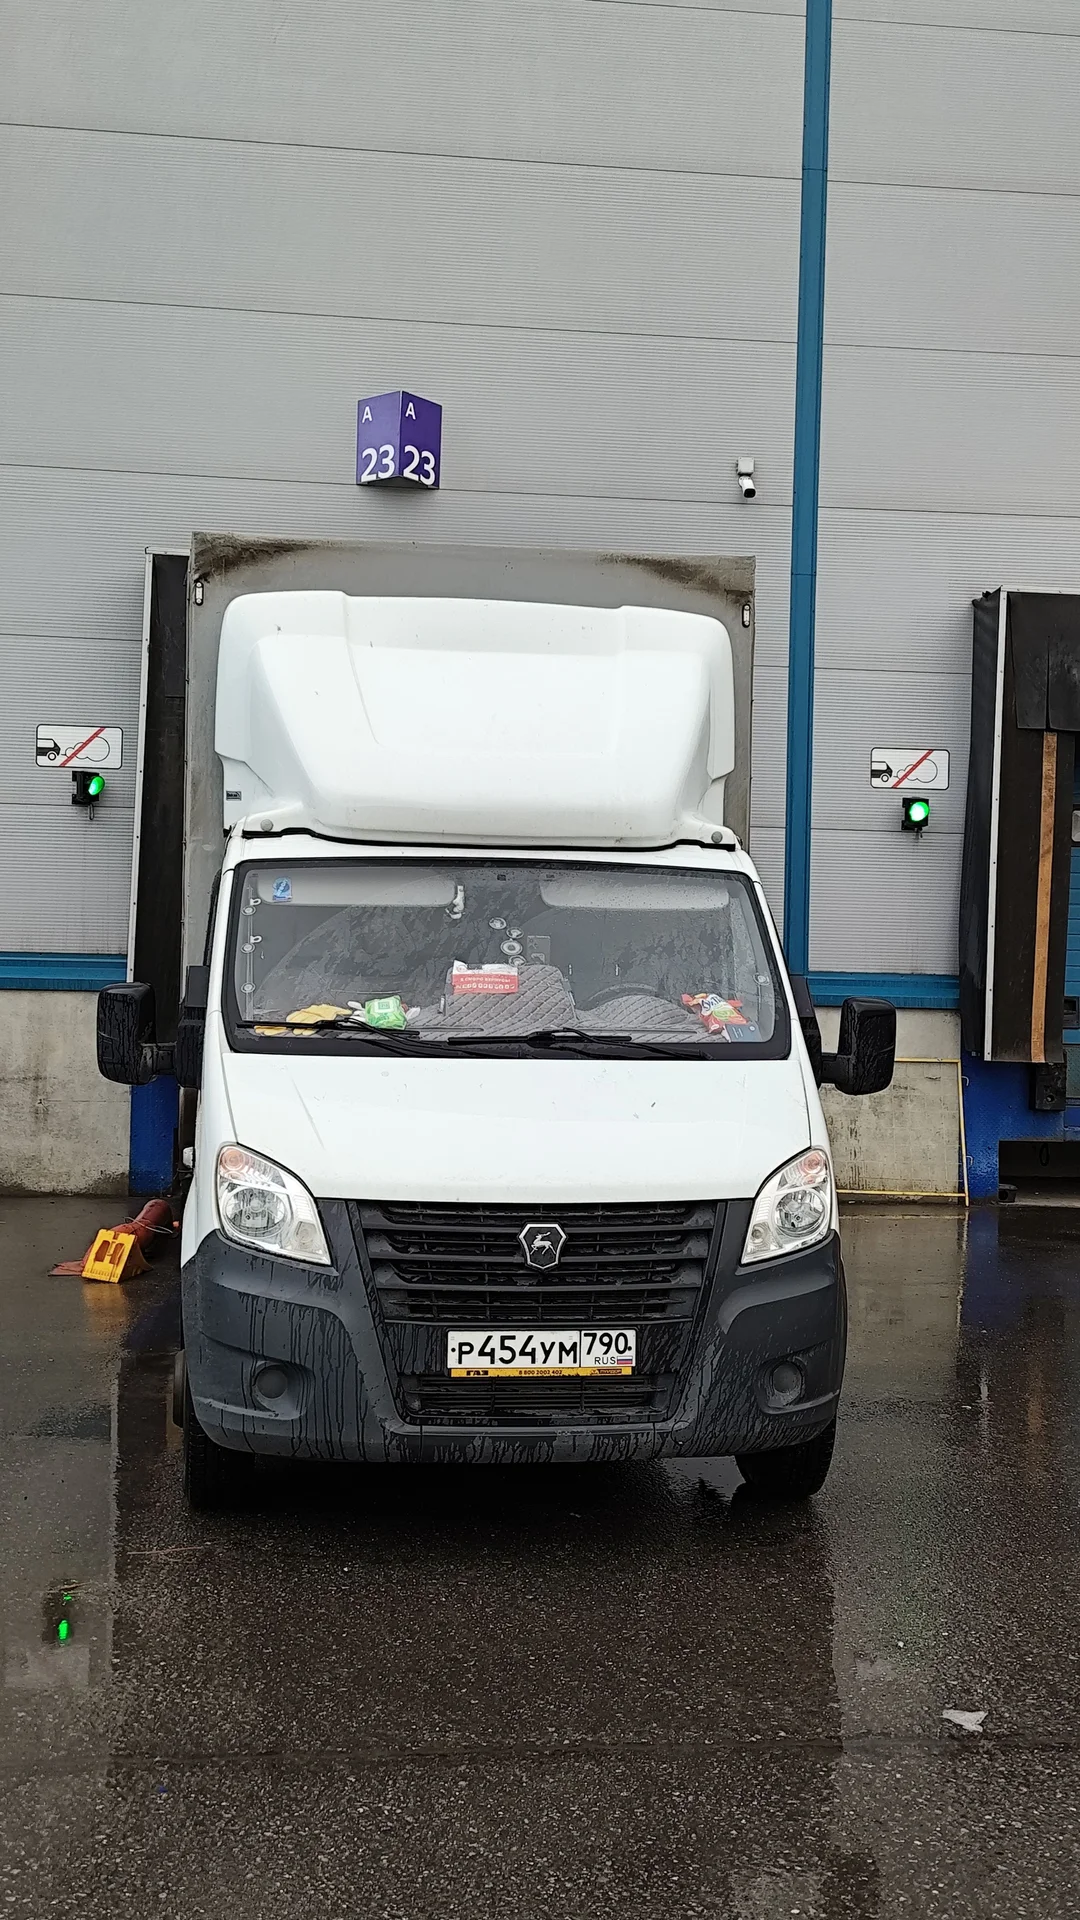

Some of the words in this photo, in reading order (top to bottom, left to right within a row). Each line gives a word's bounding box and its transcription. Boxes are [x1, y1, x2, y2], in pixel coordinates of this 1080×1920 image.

[362, 406, 373, 424] A
[405, 402, 416, 420] A
[361, 444, 395, 483] 23
[403, 445, 435, 485] 23
[458, 1335, 578, 1364] Р454УМ
[583, 1332, 629, 1355] 790
[594, 1356, 616, 1365] RUS
